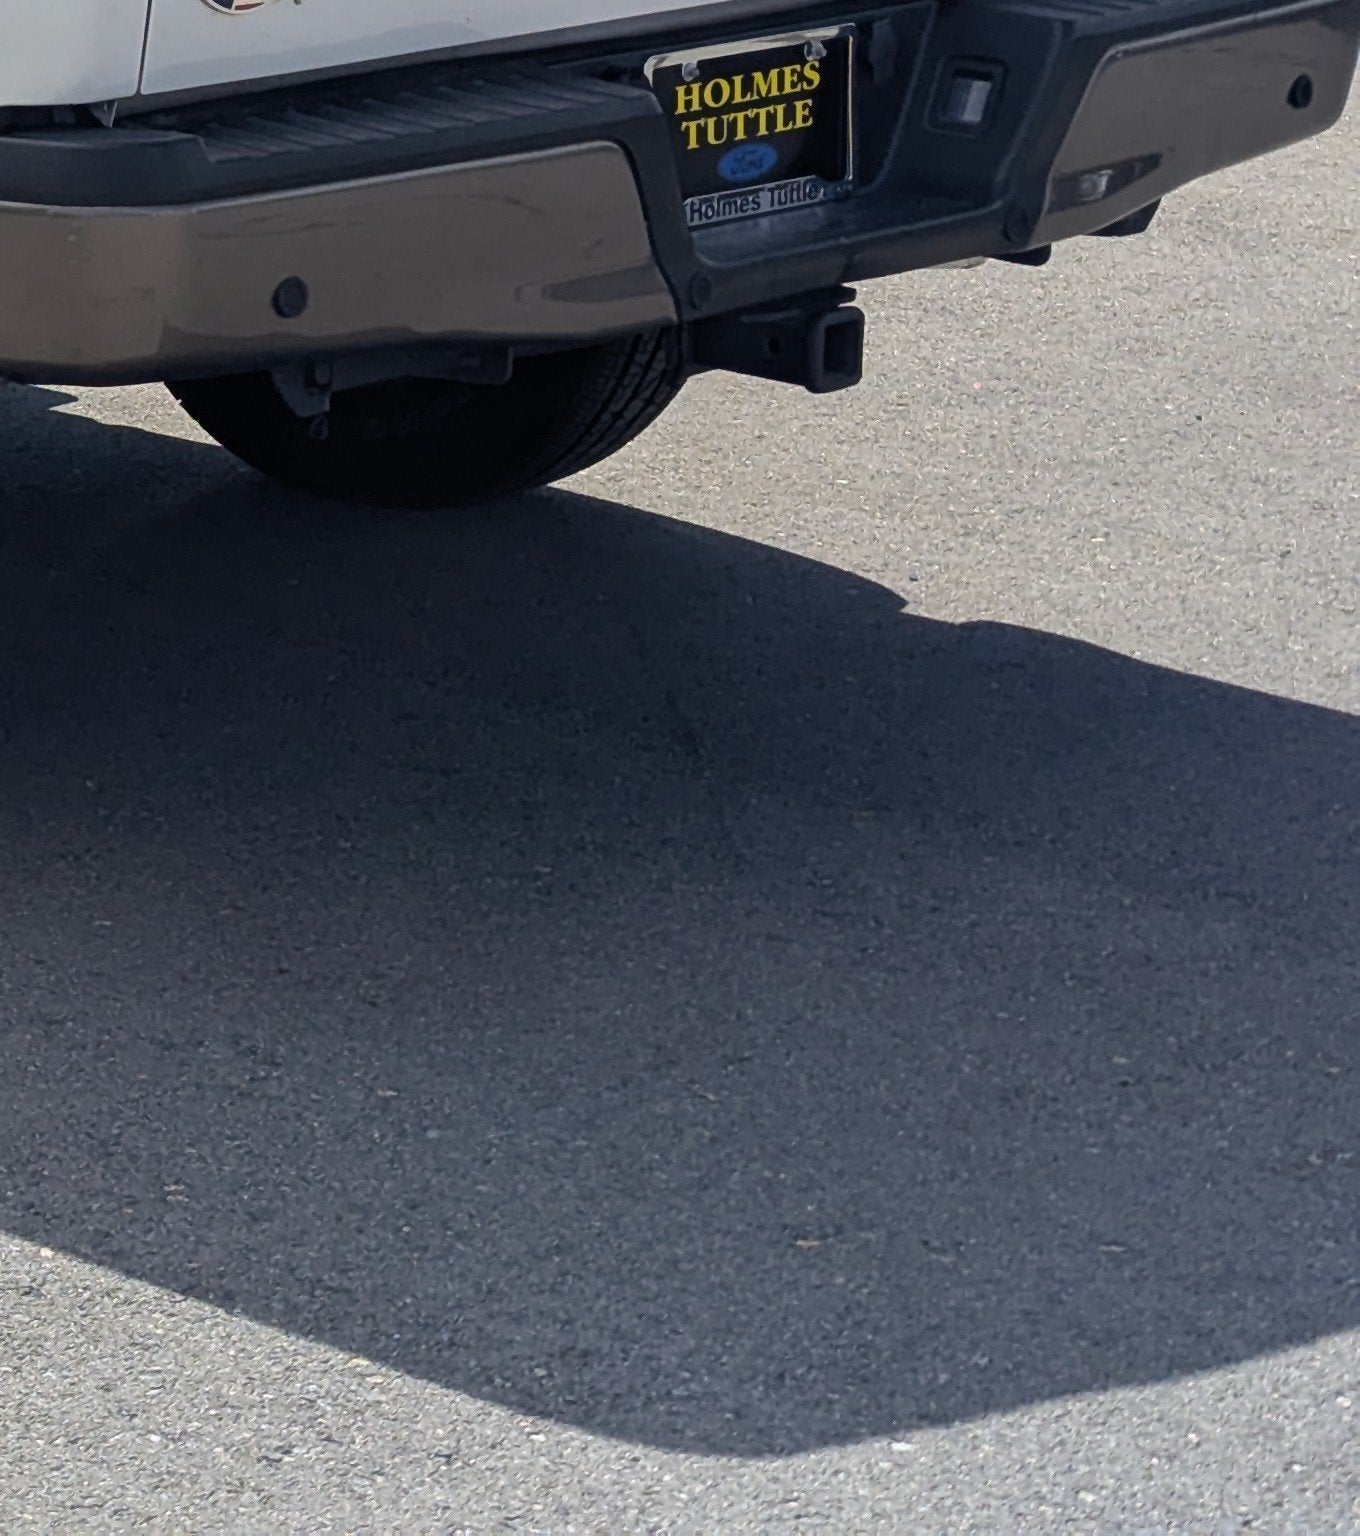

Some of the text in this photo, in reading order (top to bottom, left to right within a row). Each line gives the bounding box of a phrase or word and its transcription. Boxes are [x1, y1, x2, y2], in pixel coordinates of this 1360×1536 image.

[674, 60, 821, 115] HOLMES
[680, 98, 815, 150] TUTTLE
[688, 192, 762, 224] Holmes
